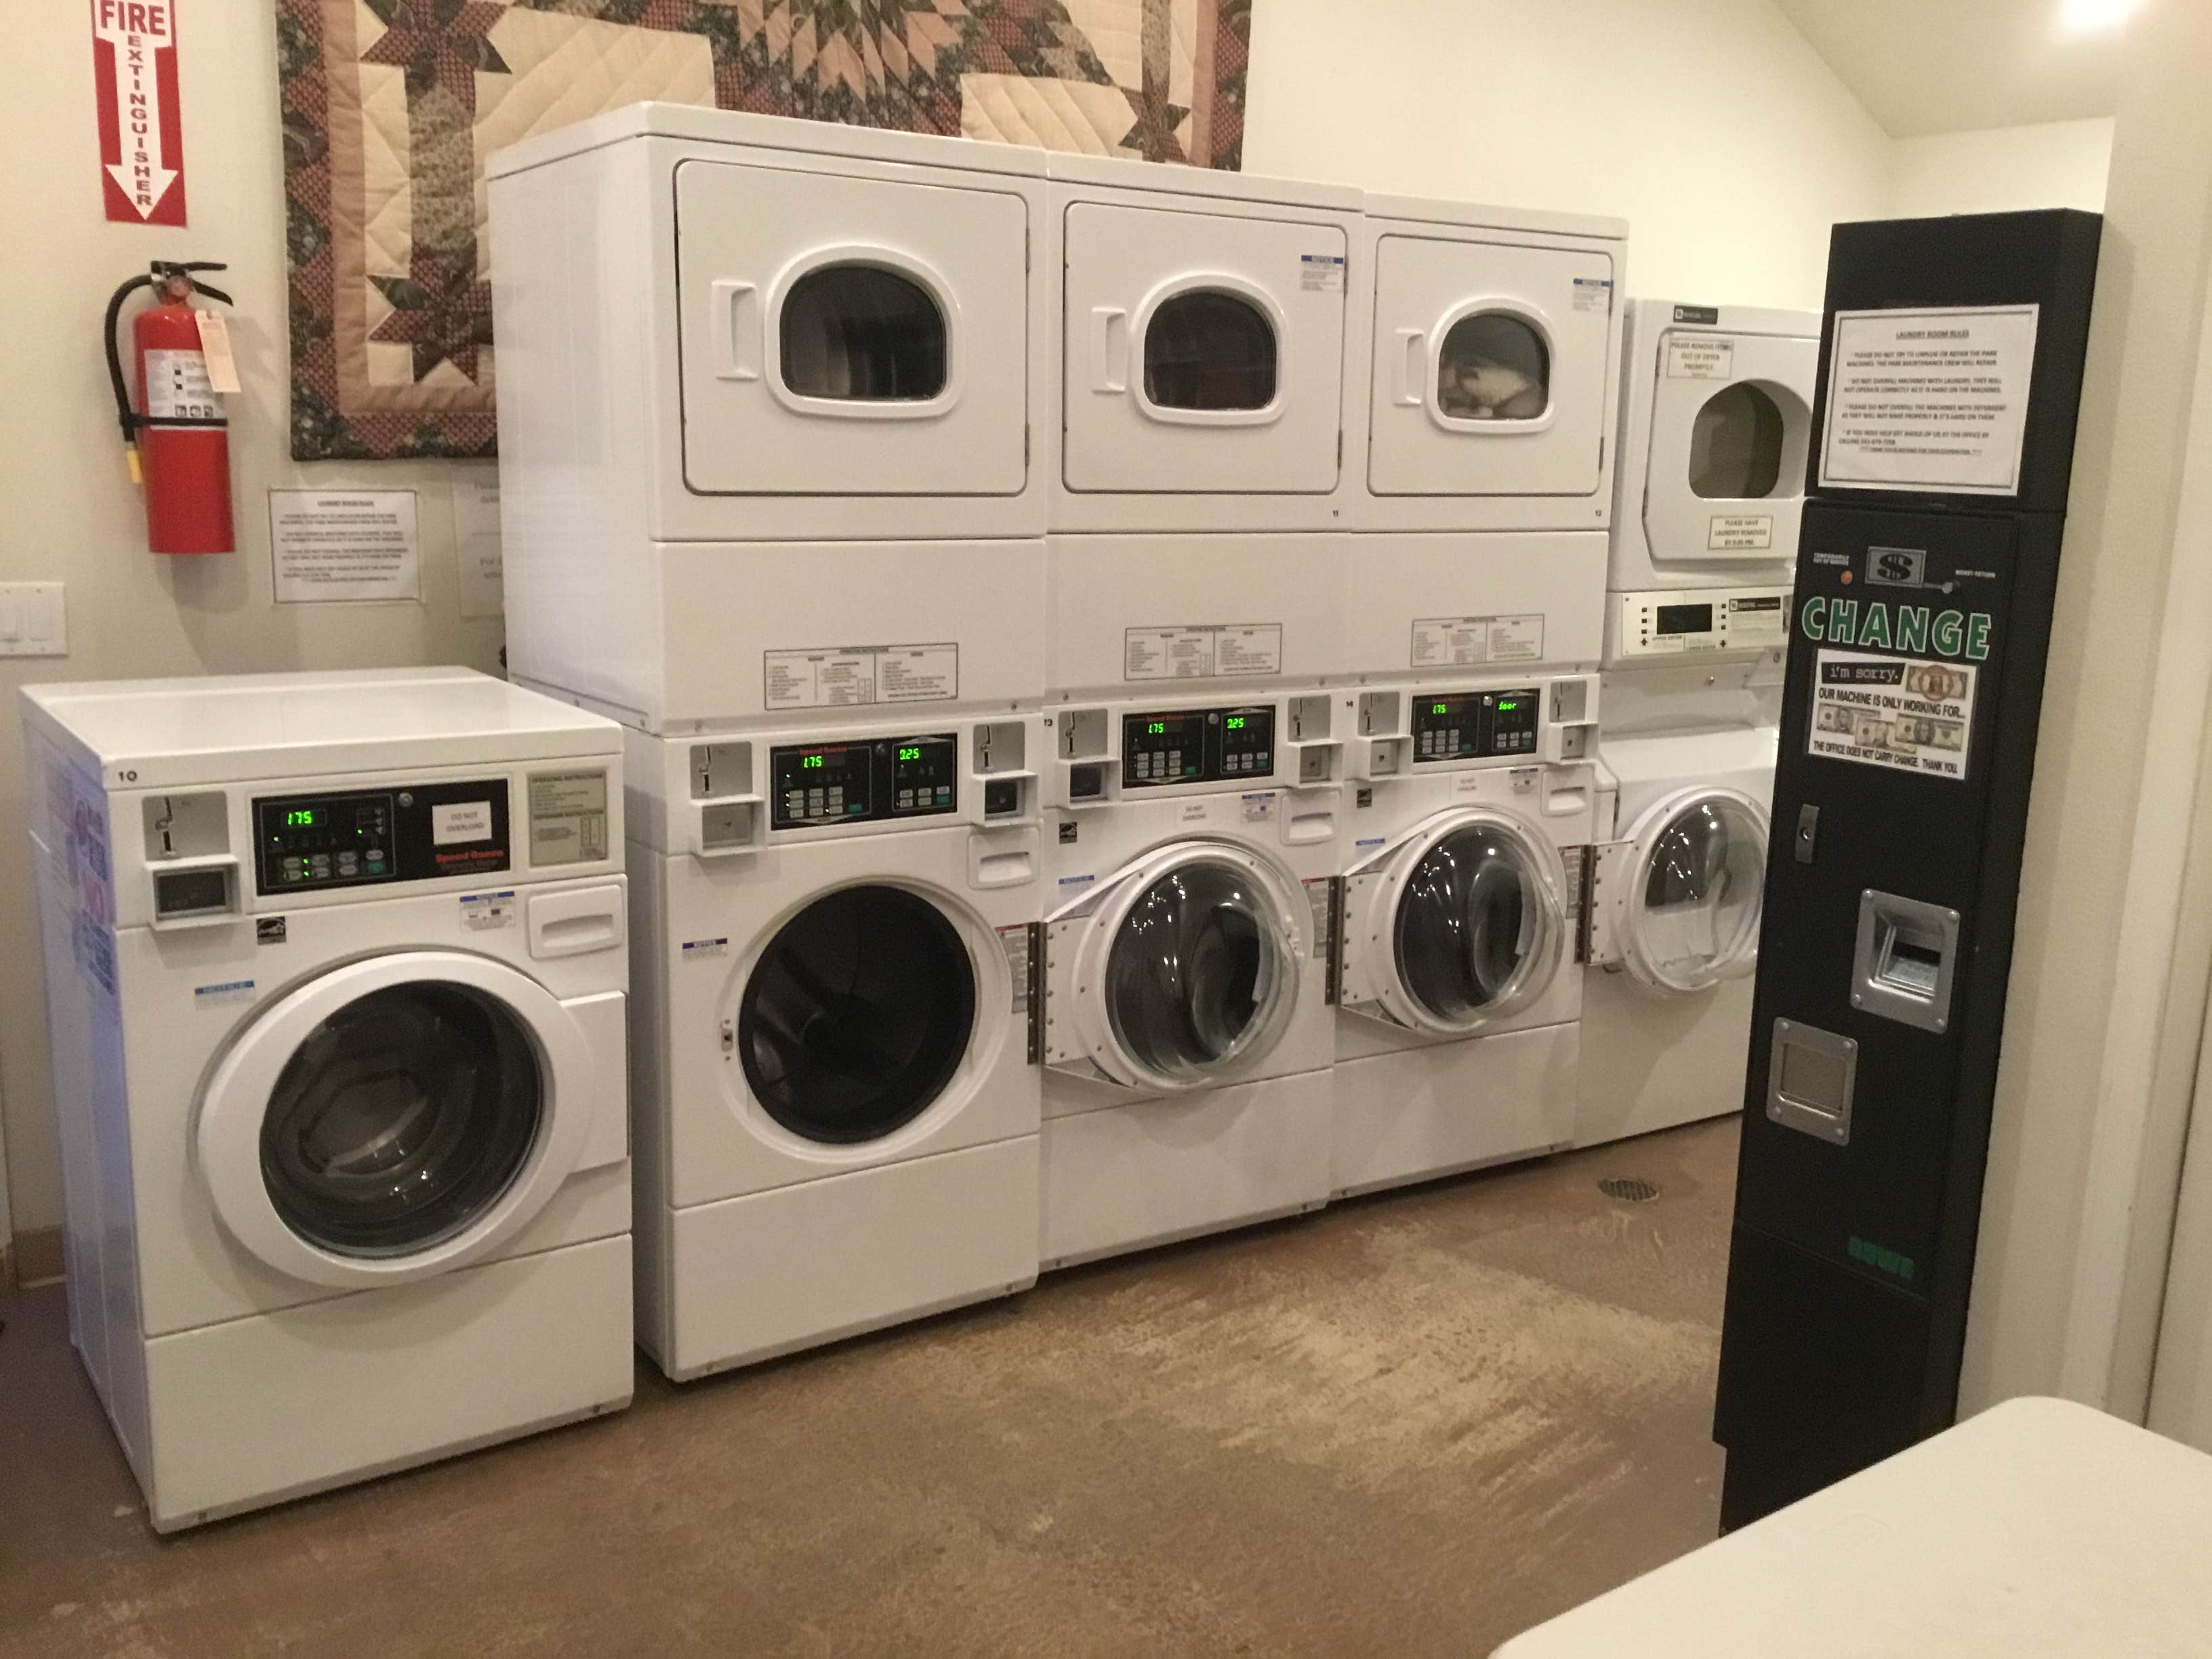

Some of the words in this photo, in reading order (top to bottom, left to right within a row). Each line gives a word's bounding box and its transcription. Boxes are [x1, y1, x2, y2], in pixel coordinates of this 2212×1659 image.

[100, 1, 167, 36] FIRE
[127, 35, 152, 206] EXTINGUISHER
[1896, 330, 1925, 339] LAUNDRY
[1927, 330, 1948, 338] ROOM
[1950, 329, 1969, 338] RULES
[1801, 596, 1992, 661] CHANGE
[1830, 665, 1850, 678] i'm
[1855, 668, 1899, 682] sorry.
[1819, 687, 1835, 700] OUR
[1837, 689, 1872, 705] MACHINE
[1873, 694, 1881, 707] IS
[1882, 695, 1902, 710] ONLY
[1903, 699, 1942, 716] WORKING
[1044, 718, 1052, 726] 13
[1814, 741, 1825, 751] THE
[1826, 743, 1845, 755] OFFICE
[1846, 745, 1862, 757] DOES
[1862, 749, 1874, 759] NOT
[1875, 750, 1893, 762] CARRY
[1923, 758, 1943, 771] THANK
[119, 770, 137, 782] 10
[446, 822, 485, 832] OVERLOAD
